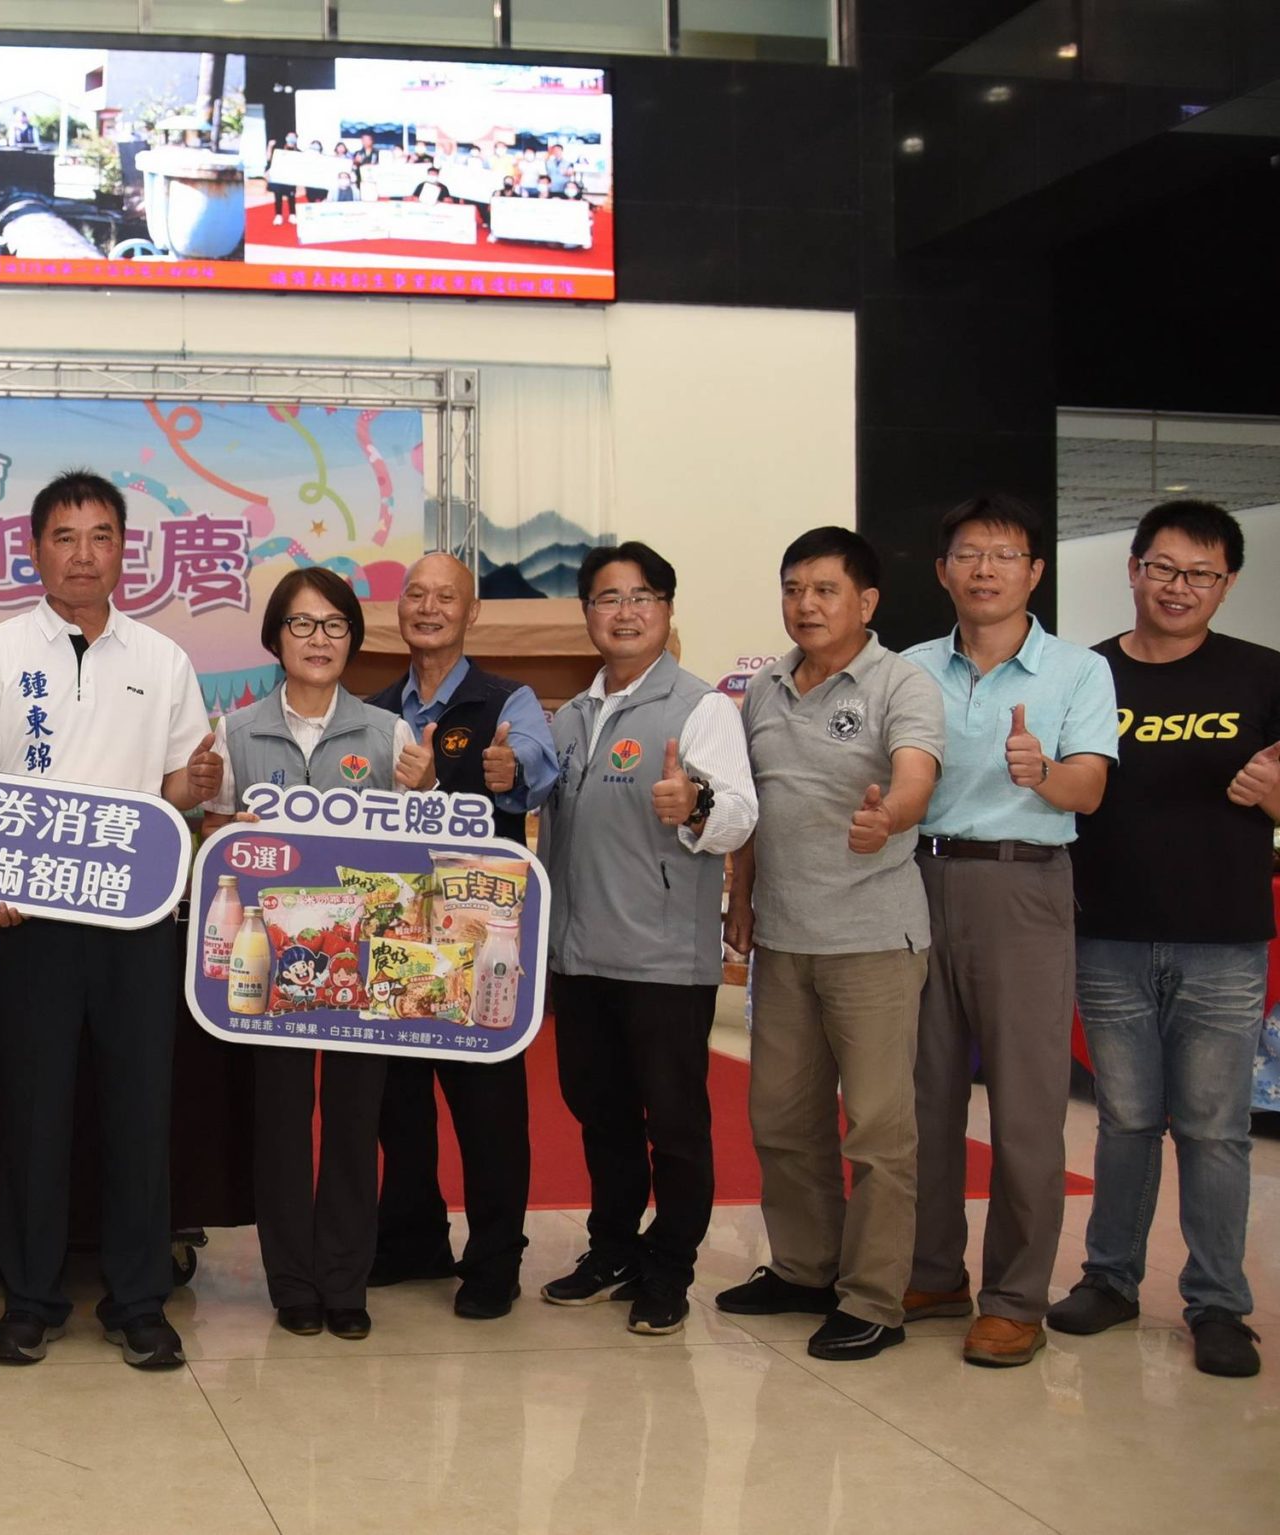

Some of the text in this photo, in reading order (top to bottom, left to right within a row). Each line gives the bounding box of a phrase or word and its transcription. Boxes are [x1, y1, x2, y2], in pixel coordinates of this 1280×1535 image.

[126, 685, 145, 696] PING
[18, 670, 54, 774] 鍾東錦
[247, 787, 489, 838] 200元贈品
[229, 841, 291, 872] 5選1
